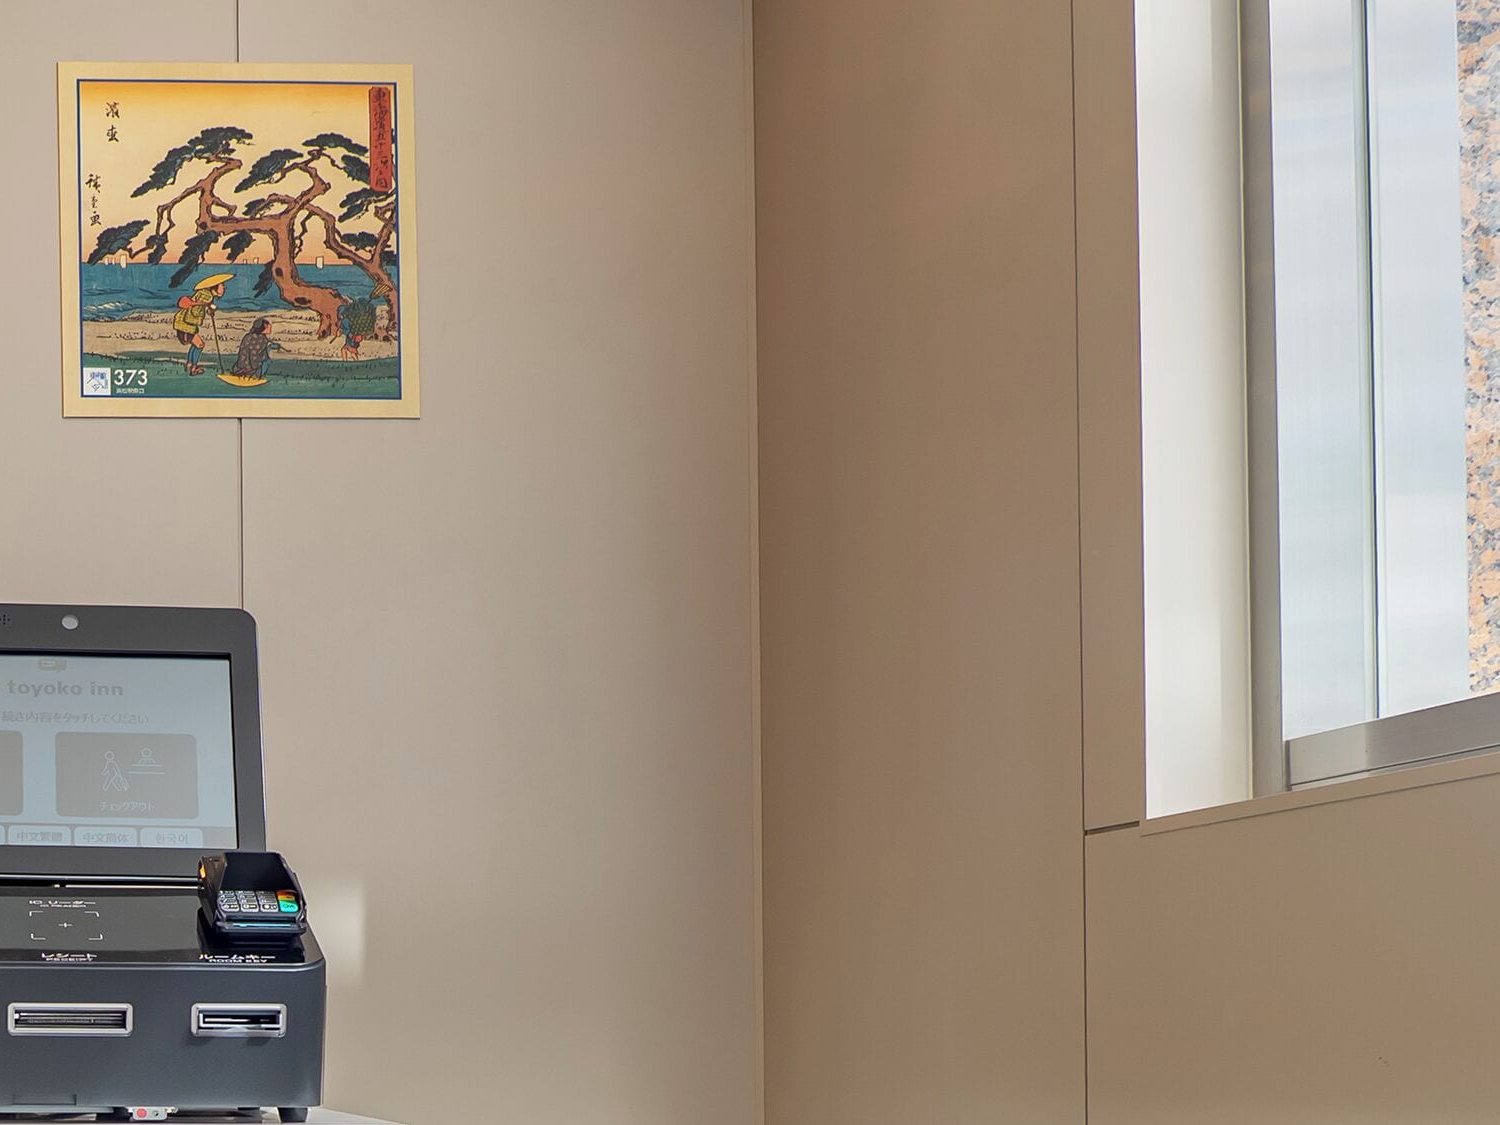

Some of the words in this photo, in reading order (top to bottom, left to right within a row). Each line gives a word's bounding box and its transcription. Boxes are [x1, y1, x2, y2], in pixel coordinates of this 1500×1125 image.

[114, 369, 148, 385] 373
[7, 680, 83, 698] toyoko
[90, 681, 124, 696] inn
